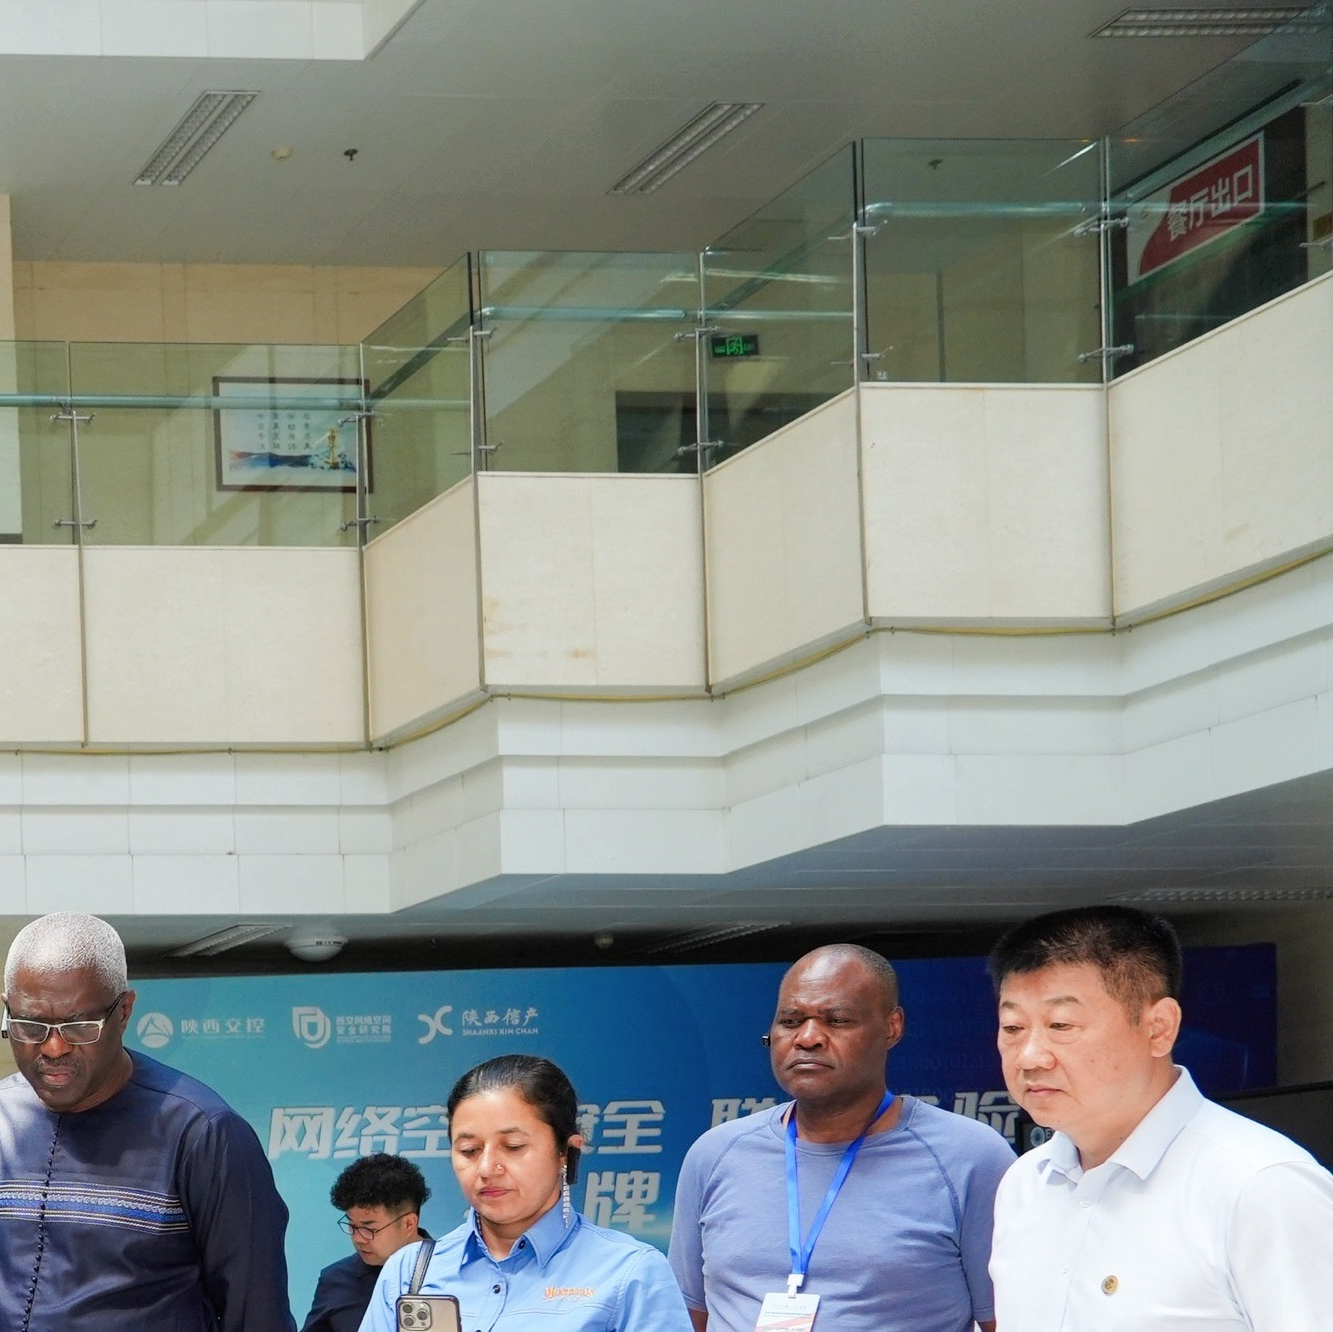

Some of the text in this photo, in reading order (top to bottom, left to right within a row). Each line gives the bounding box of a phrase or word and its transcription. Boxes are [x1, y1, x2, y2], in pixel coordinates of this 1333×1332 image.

[1167, 164, 1253, 242] 餐厅出口
[181, 1018, 265, 1034] 陕西交控
